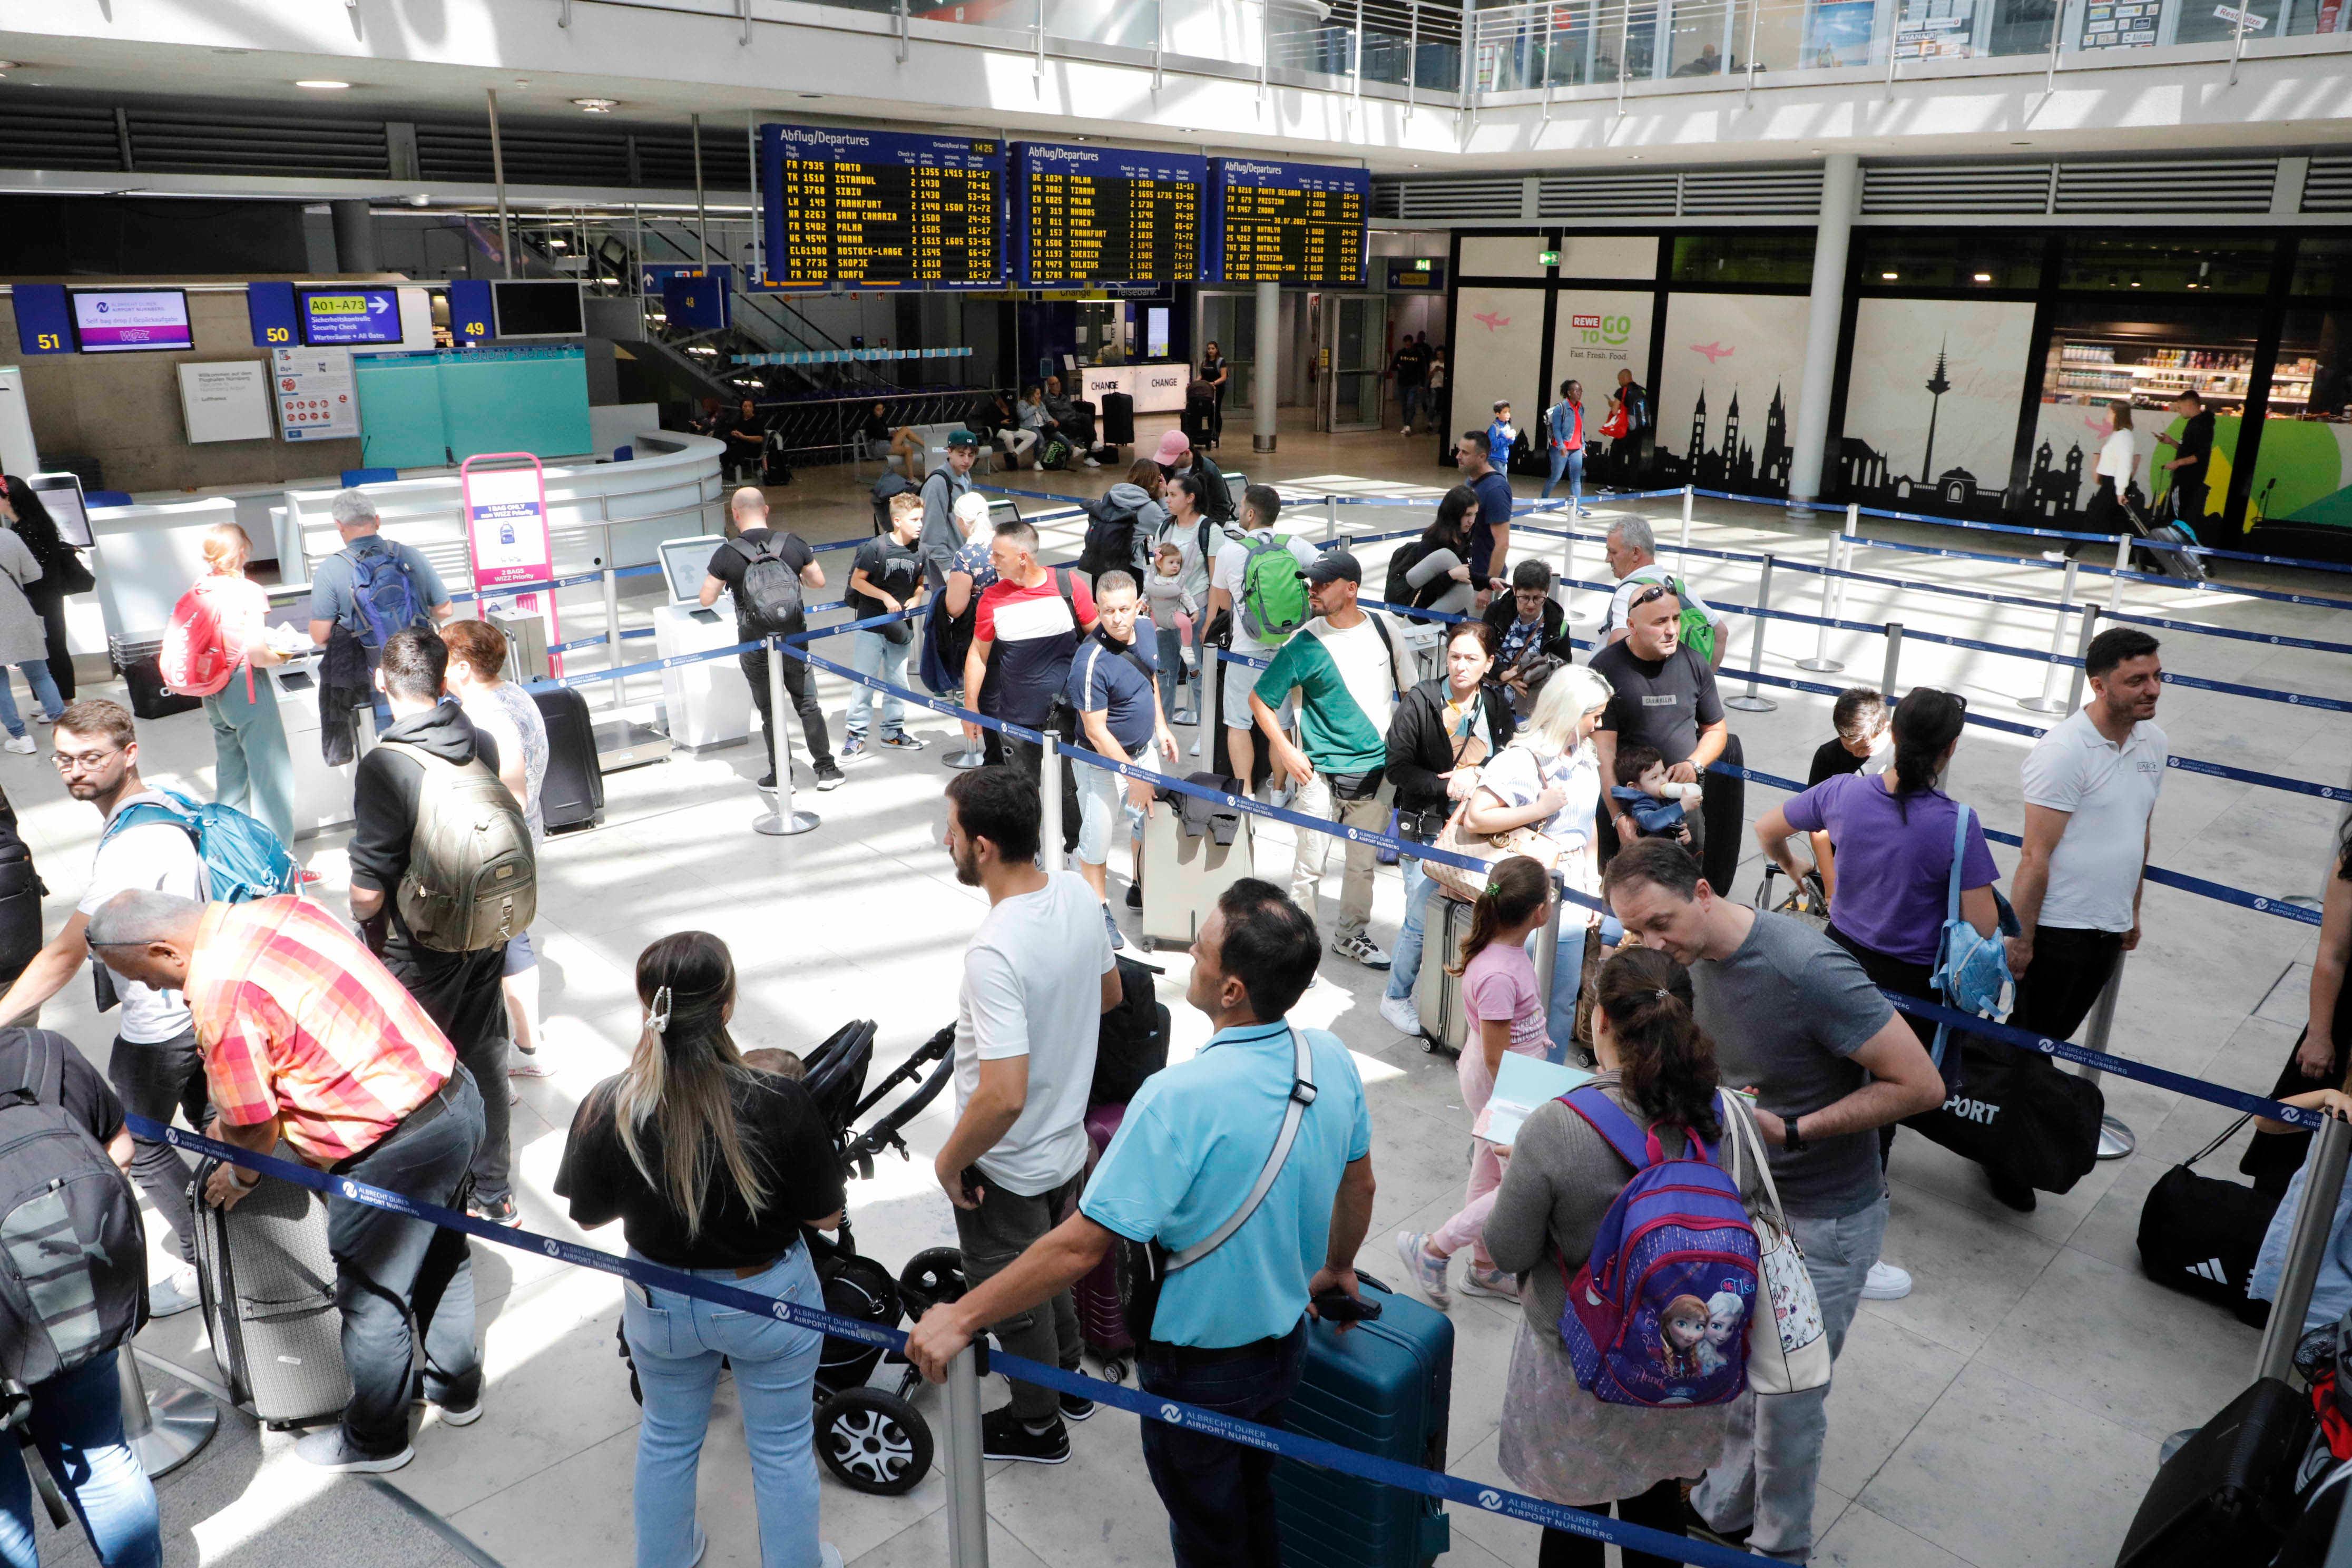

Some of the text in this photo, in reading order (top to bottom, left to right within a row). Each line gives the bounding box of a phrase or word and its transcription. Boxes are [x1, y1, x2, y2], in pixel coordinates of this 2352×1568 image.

[1899, 33, 1935, 41] RYANAIR
[780, 129, 869, 146] Abflug/Departures
[1028, 146, 1099, 161] Abflug/Departures
[1225, 161, 1281, 174] Abflug/Departures
[312, 300, 365, 311] A01-A73
[465, 322, 484, 335] 49
[1574, 318, 1599, 327] REWE
[38, 334, 60, 349] 51
[267, 328, 289, 342] 50
[1581, 330, 1599, 344] TO
[1571, 351, 1584, 359] Fast.
[1587, 351, 1607, 360] Fresh.
[1151, 378, 1178, 388] CHANGE
[2057, 1050, 2087, 1062] AIRPORT
[2059, 1044, 2093, 1058] ALBRECHT
[358, 1188, 388, 1201] ALBRECHT
[360, 1194, 385, 1207] AIRPORT
[793, 1308, 831, 1324] ALBRECHT
[794, 1315, 827, 1329] AIRPORT
[1187, 1412, 1232, 1429] ALBRECHT
[1187, 1419, 1225, 1435] AIRPORT
[1508, 1498, 1561, 1517] ALBRECHT
[1507, 1507, 1552, 1524] AIRPORT
